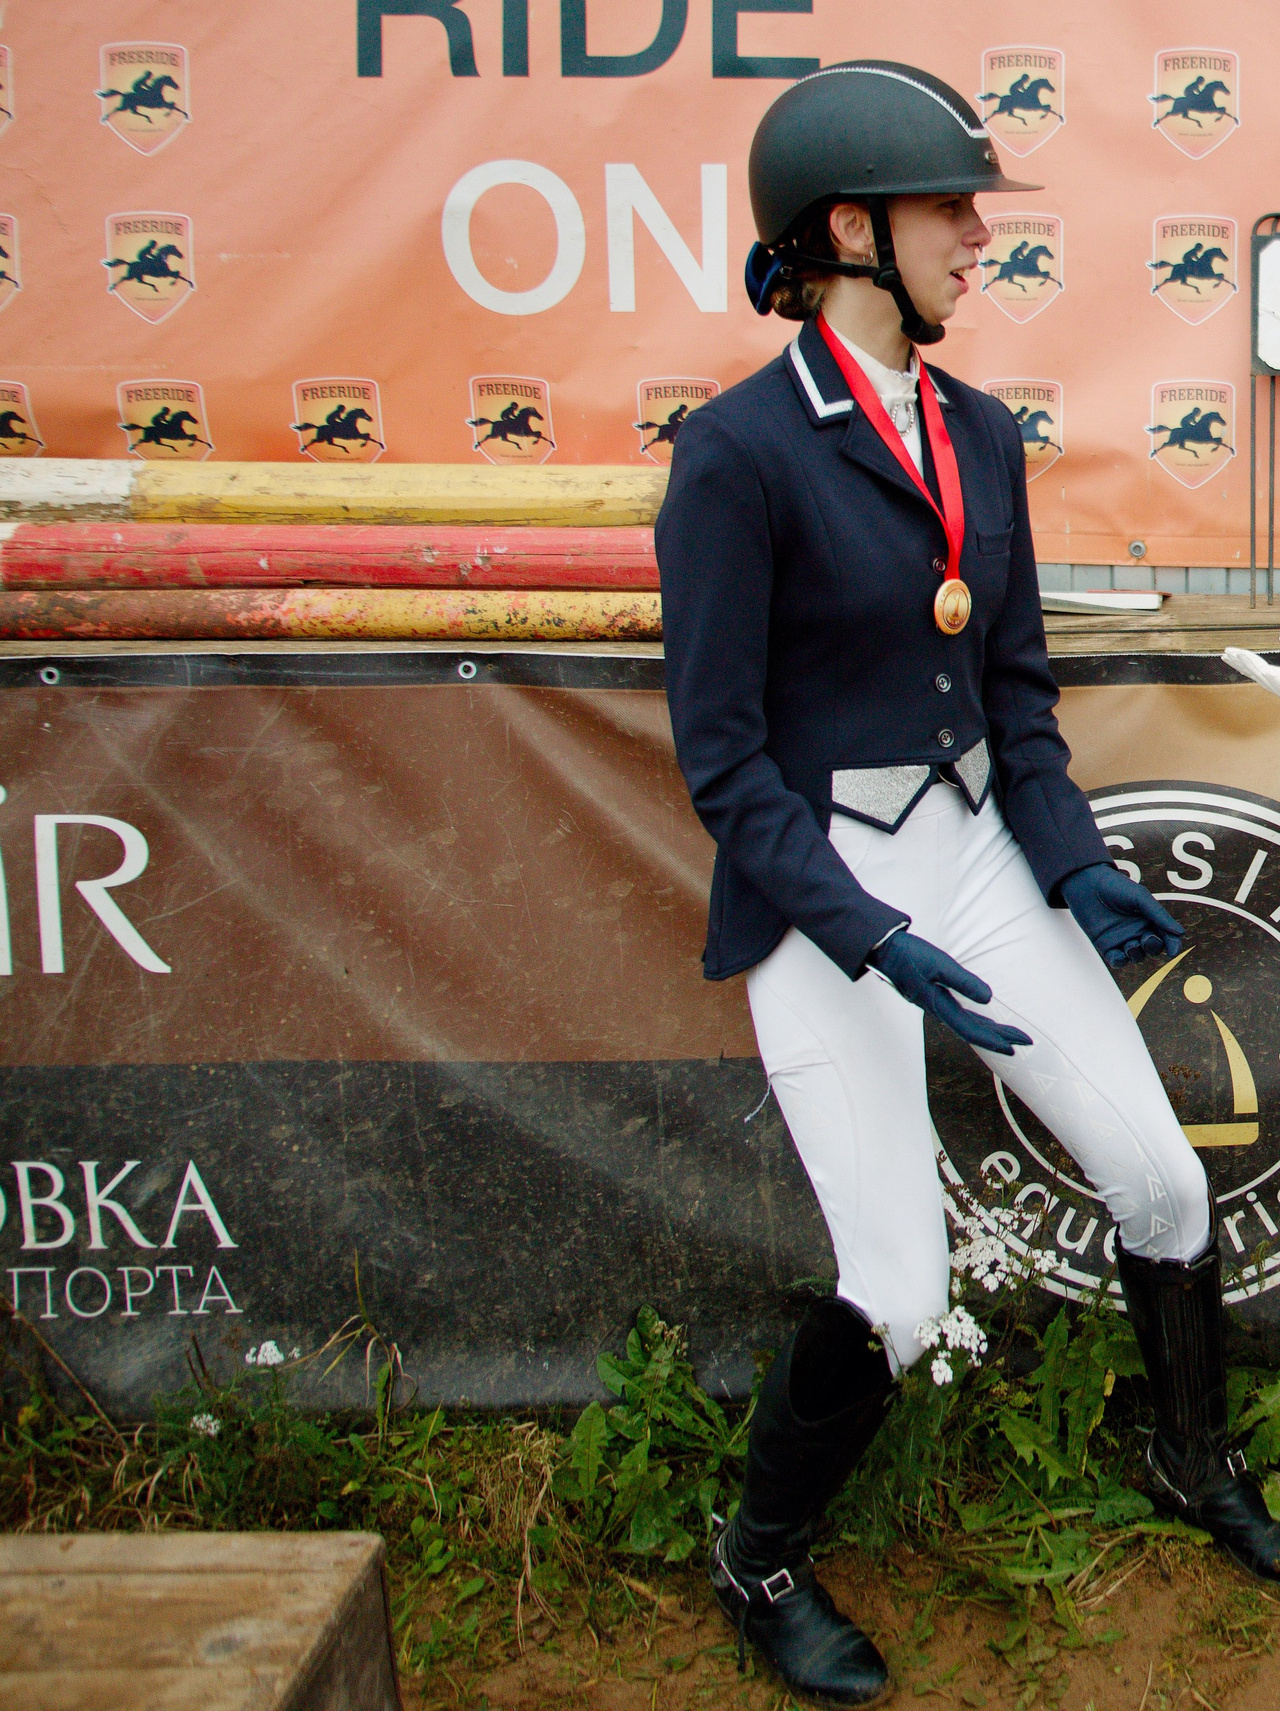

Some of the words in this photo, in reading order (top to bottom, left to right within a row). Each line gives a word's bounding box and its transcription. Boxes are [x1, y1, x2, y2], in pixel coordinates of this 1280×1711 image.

[109, 50, 179, 67] FREERIDE
[990, 54, 1055, 70] FREERIDE
[1164, 57, 1231, 72] FREERIDE
[115, 220, 183, 236] FREERIDE
[991, 222, 1055, 237] FREERIDE
[1162, 224, 1229, 239] FREERIDE
[441, 158, 728, 316] ON
[126, 388, 195, 403] FREERIDE
[302, 386, 370, 401] FREERIDE
[478, 383, 541, 400] FREERIDE
[646, 386, 713, 400] FREERIDE
[1160, 388, 1227, 403] FREERIDE
[0, 1159, 239, 1249] ВКА
[6, 1265, 244, 1319] ПОРТА
